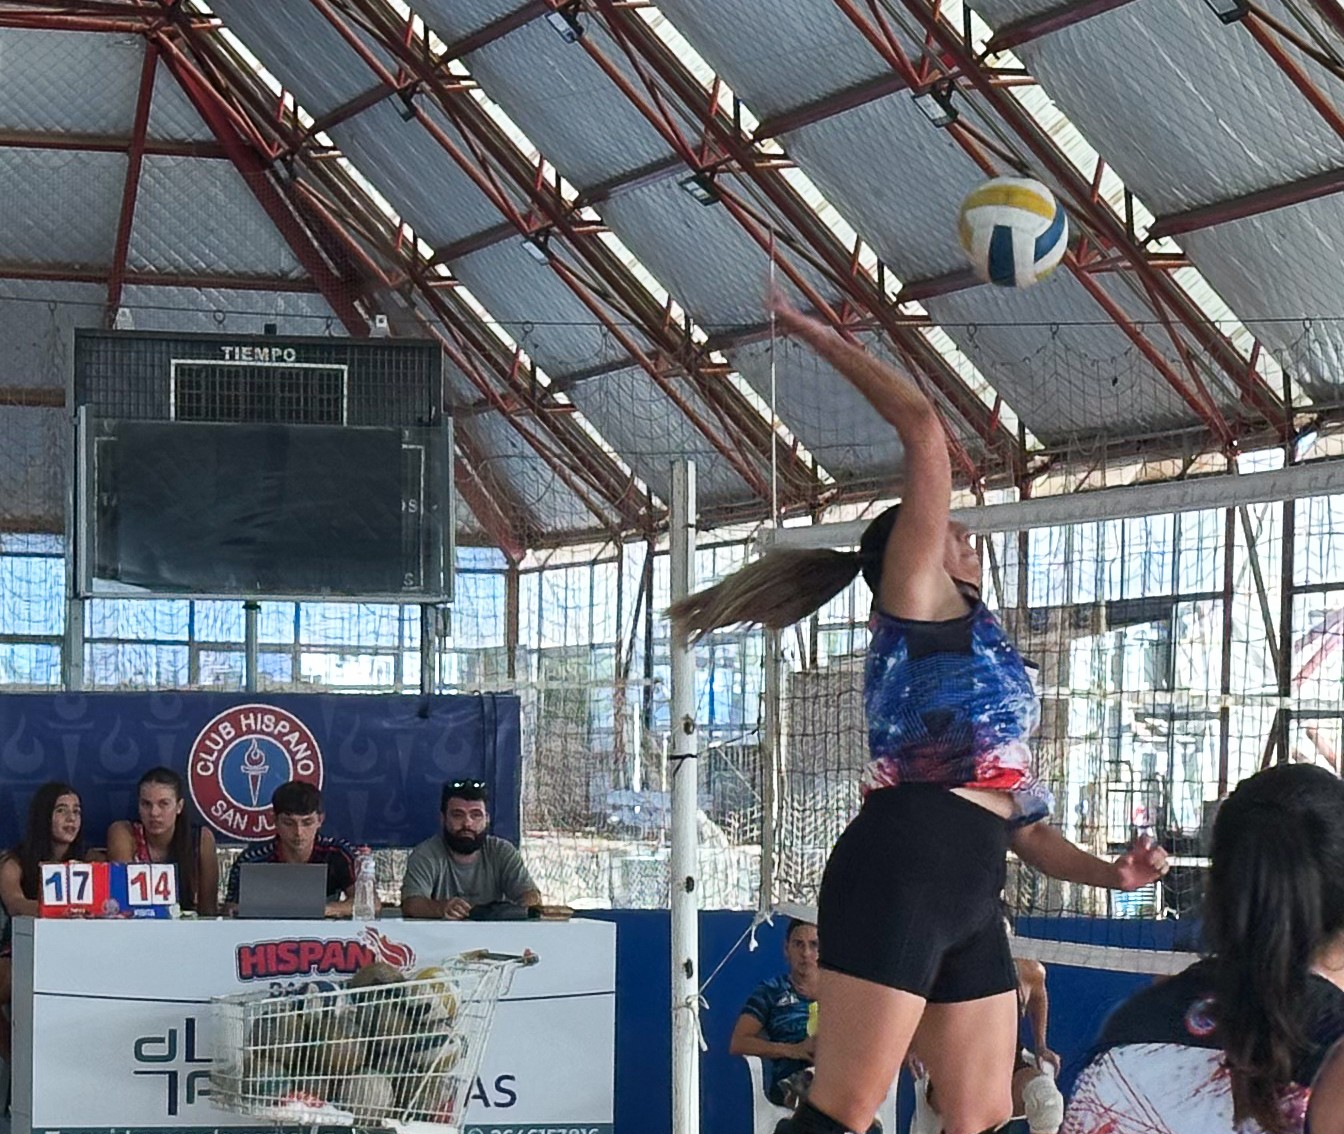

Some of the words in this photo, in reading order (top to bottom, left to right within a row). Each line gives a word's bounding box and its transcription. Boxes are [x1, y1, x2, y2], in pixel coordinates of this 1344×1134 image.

[221, 346, 297, 363] TIEMPO
[196, 721, 236, 776] CLUB
[240, 712, 315, 776] HISPANO
[211, 800, 248, 831] SAN
[252, 815, 277, 832] JU
[45, 871, 89, 902] 17
[130, 871, 171, 902] 14
